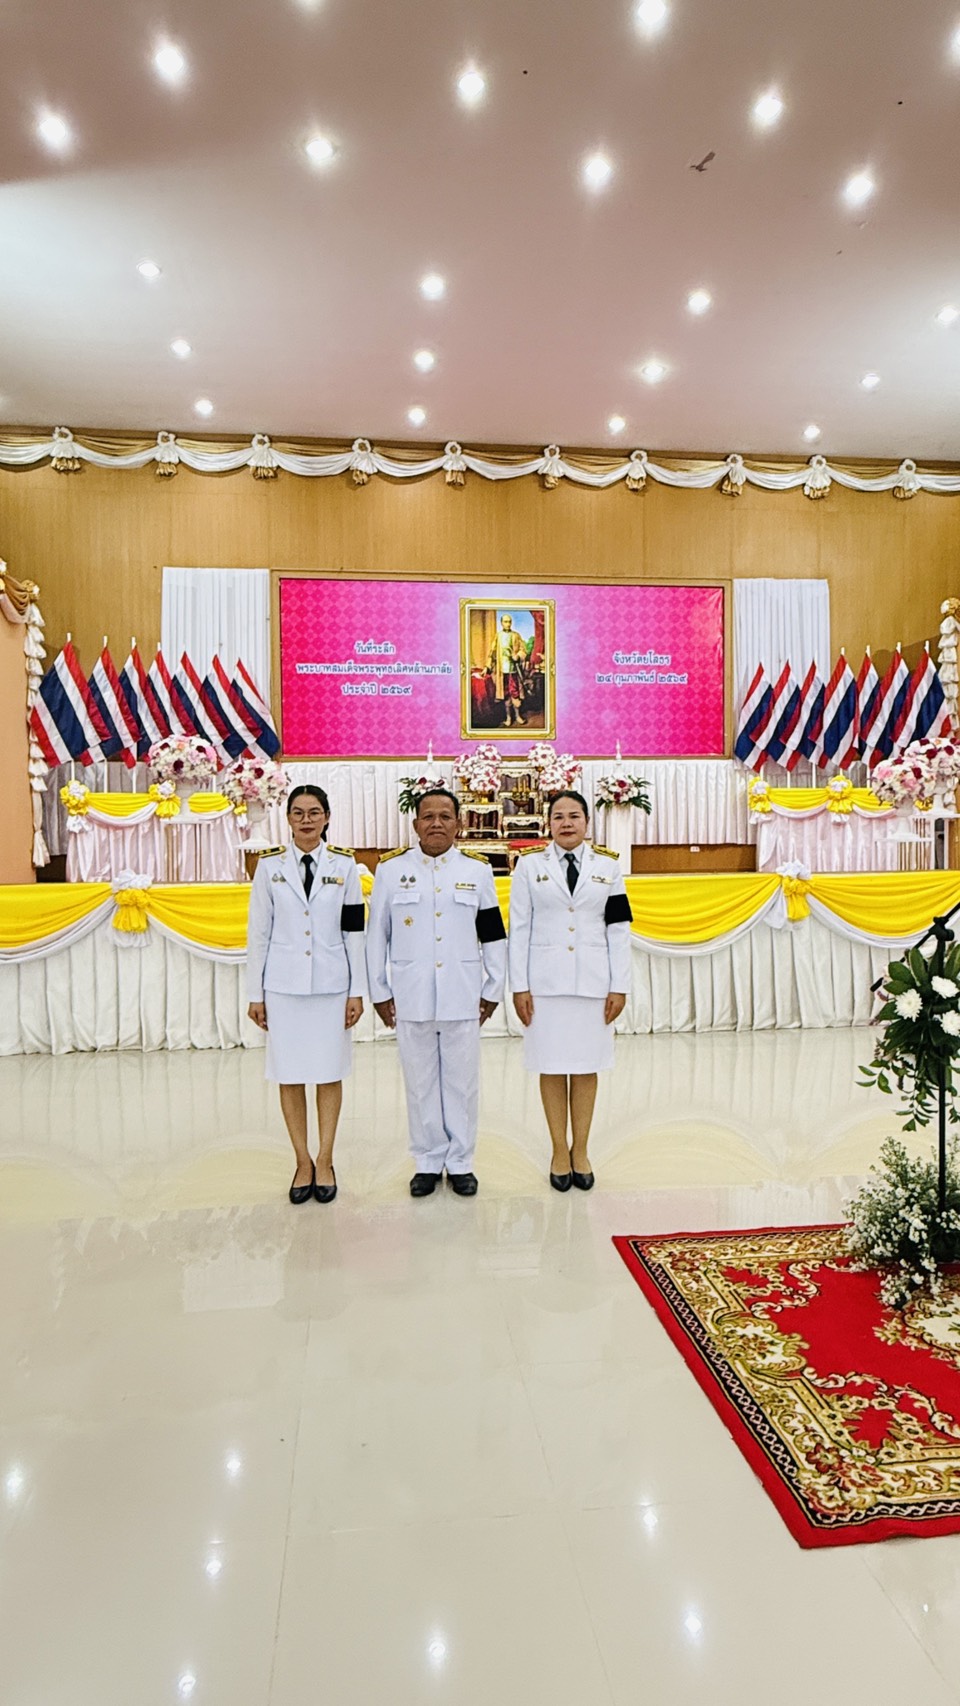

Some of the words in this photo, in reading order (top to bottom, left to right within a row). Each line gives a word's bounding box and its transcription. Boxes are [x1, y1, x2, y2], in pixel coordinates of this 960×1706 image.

[355, 639, 395, 654] วันที่ระลึก
[614, 651, 670, 665] จังหวัดยโสธร
[296, 661, 453, 677] พระบาทสมเด็จพระพุทธเลิศหล้านภาลัย
[615, 671, 655, 686] กุมภาพันธ์
[658, 674, 687, 684] ๒๕๖๙
[342, 683, 377, 694] ประจำปี
[380, 685, 411, 694] ๒๕๖๙
